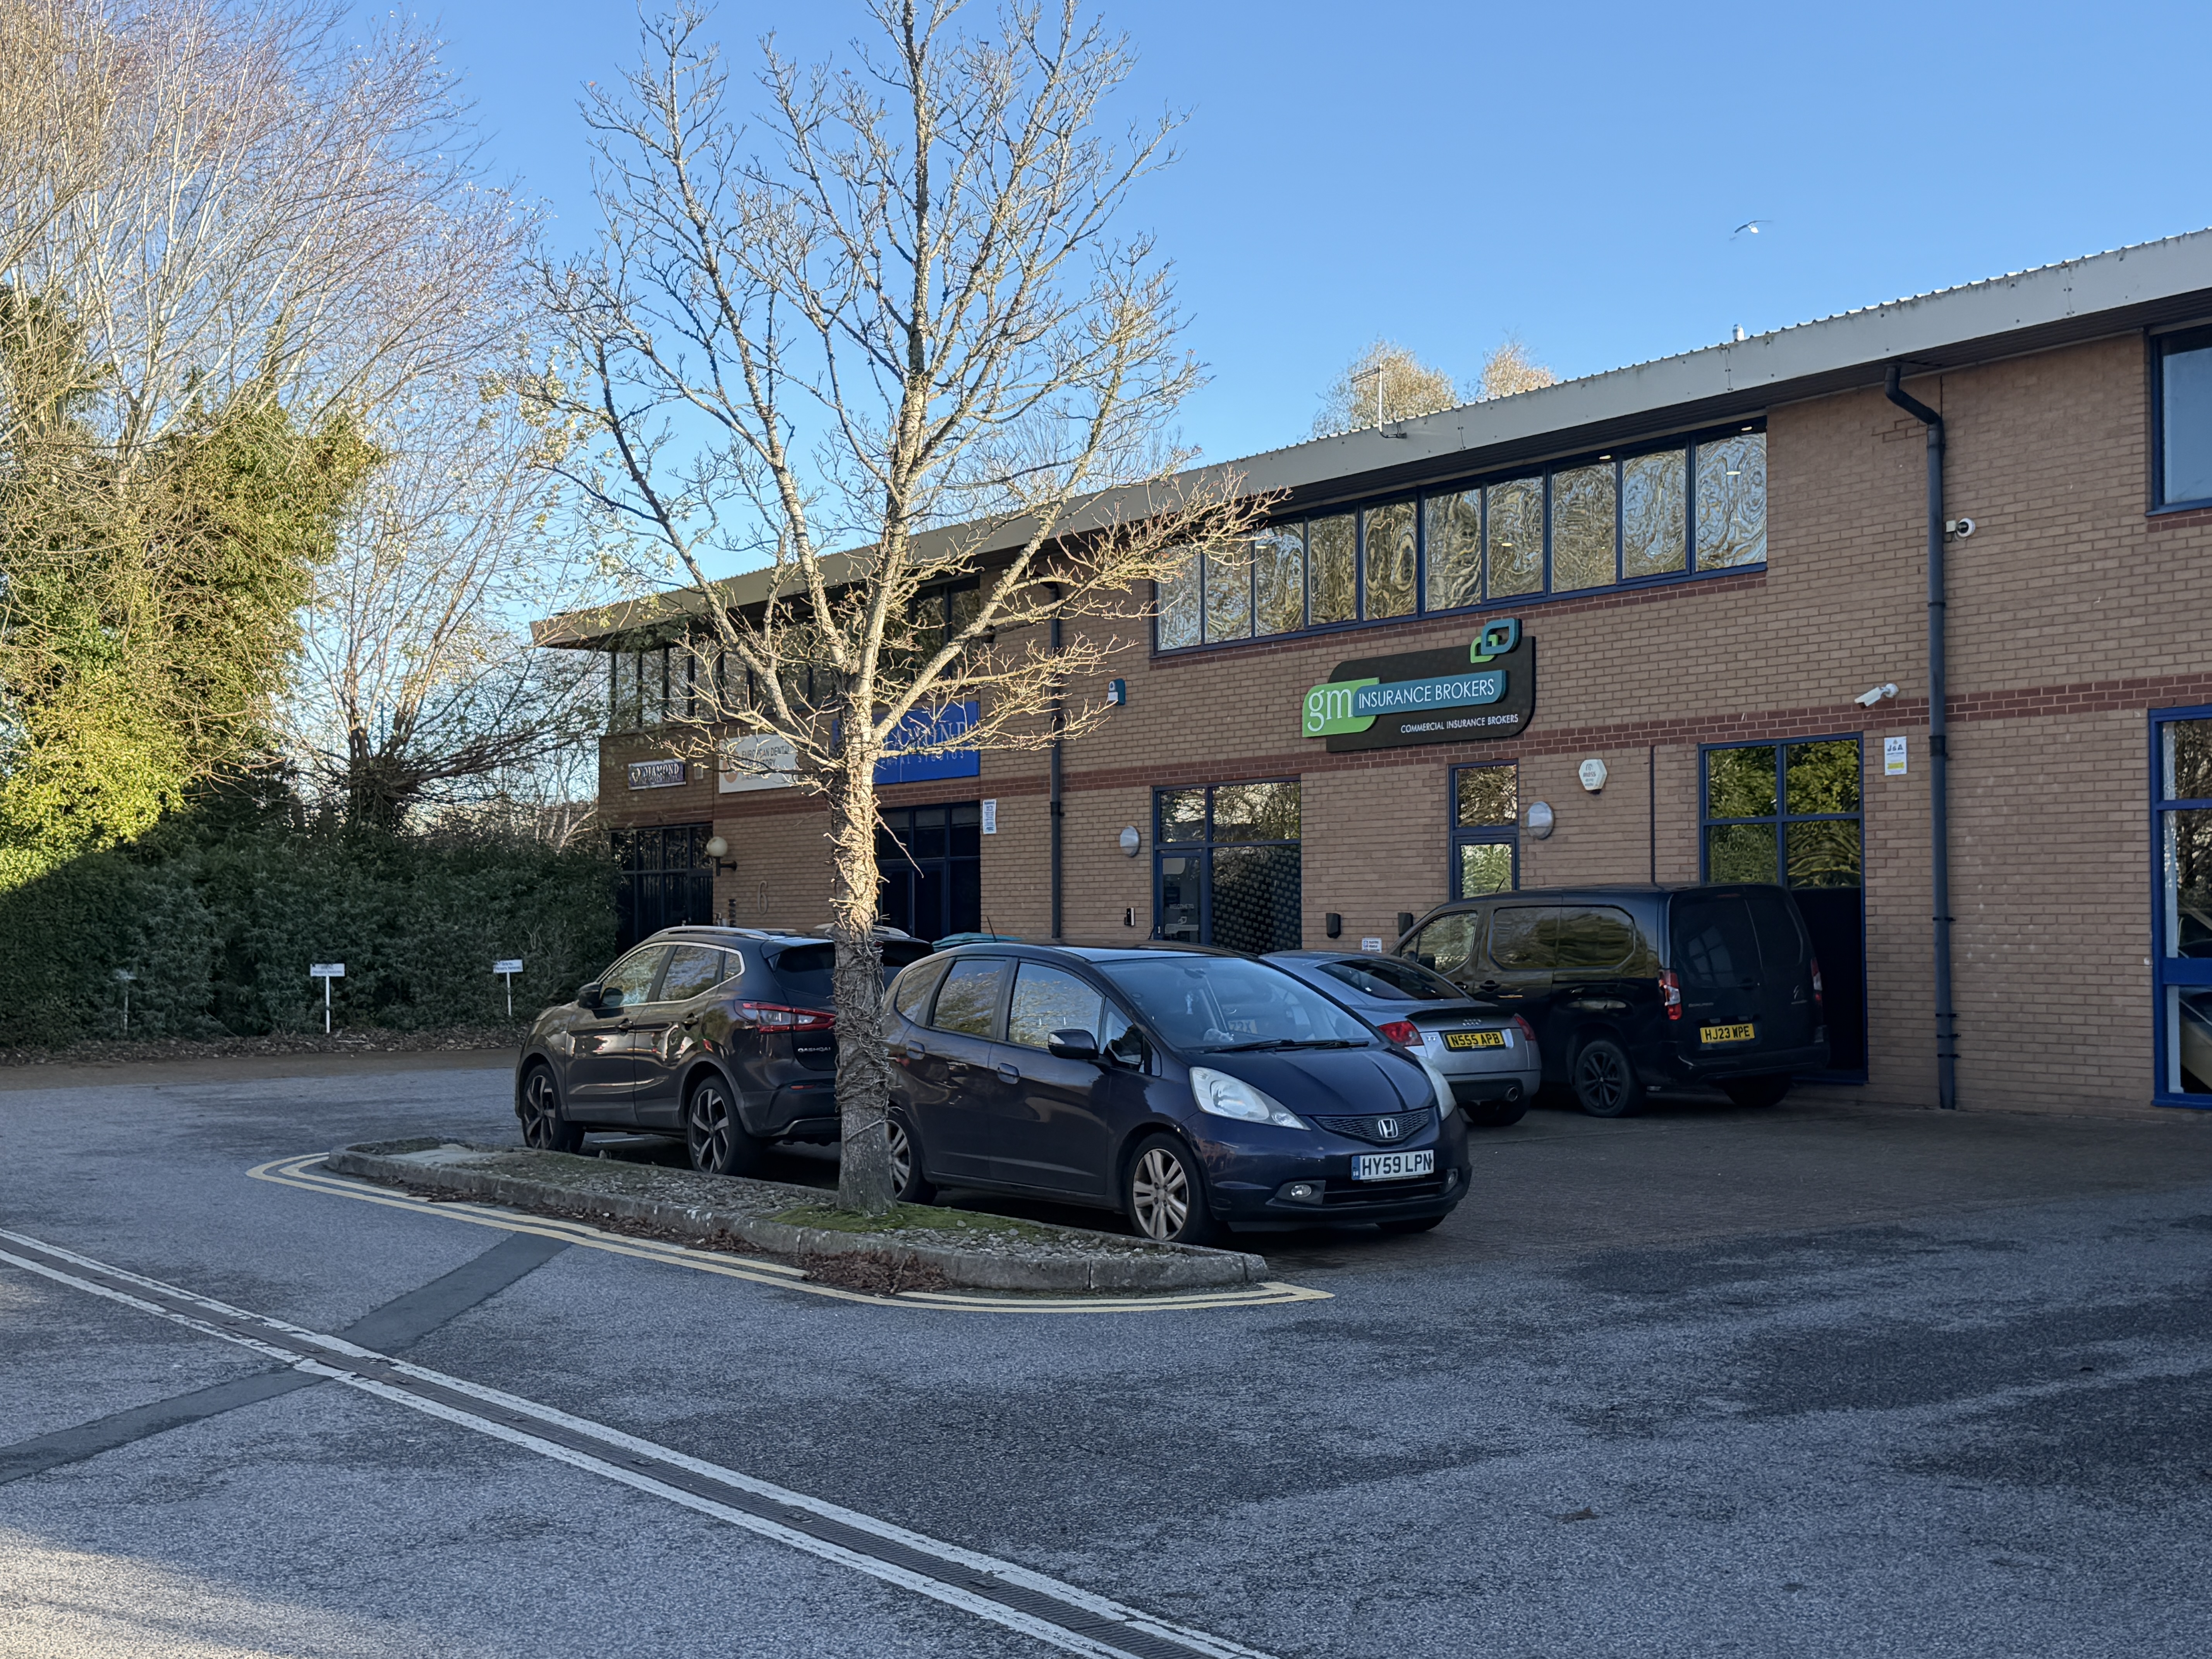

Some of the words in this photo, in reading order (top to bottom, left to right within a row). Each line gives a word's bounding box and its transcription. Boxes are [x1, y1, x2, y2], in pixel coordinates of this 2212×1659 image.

[1307, 689, 1353, 732] gm
[1358, 685, 1432, 709] INSURANCE
[1435, 678, 1494, 701] BROKERS
[1400, 721, 1444, 733] COMMERCIAL
[1446, 717, 1486, 729] INSURANCE
[1487, 714, 1518, 725] BROKERS
[758, 880, 769, 915] 6
[1481, 1033, 1500, 1044] APB
[1705, 1027, 1730, 1041] HJ23
[1732, 1025, 1750, 1038] WPE
[1362, 1156, 1401, 1176] HY59
[1405, 1153, 1432, 1173] LPN
